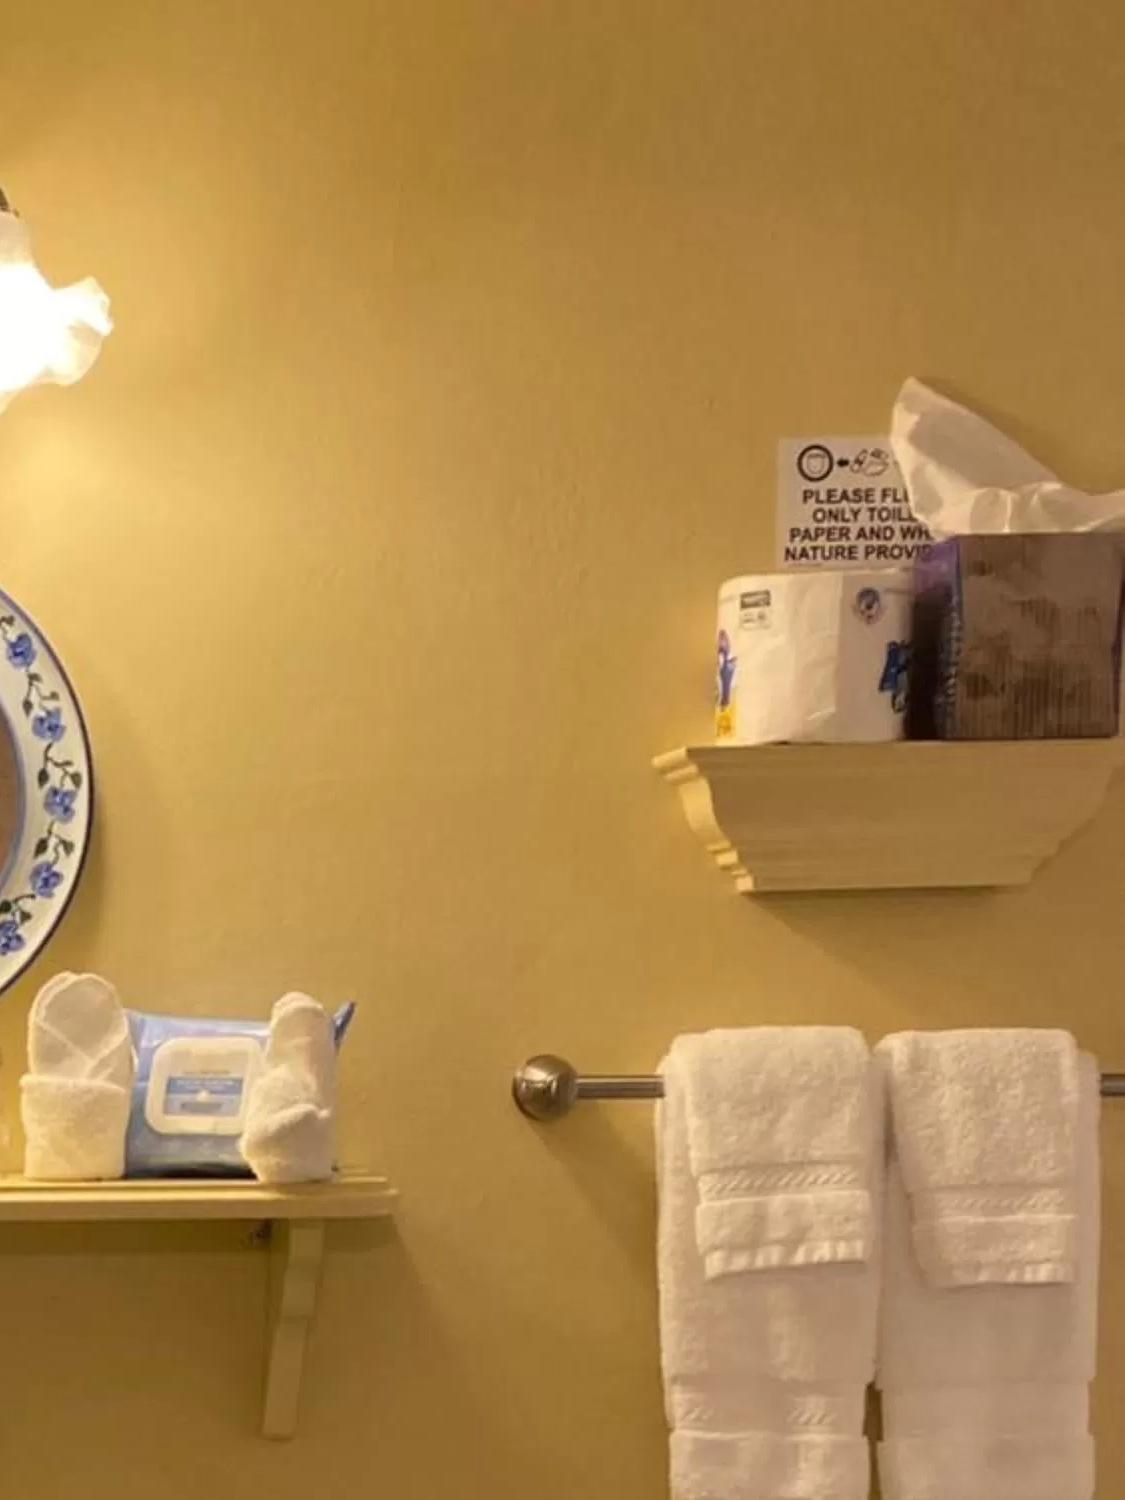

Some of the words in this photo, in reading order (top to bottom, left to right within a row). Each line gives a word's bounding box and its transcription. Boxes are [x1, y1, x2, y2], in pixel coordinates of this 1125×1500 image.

[802, 487, 876, 505] PLEASE
[812, 507, 861, 524] ONLY
[789, 526, 851, 543] PAPER
[855, 526, 895, 542] AND
[784, 545, 859, 562] NATURE
